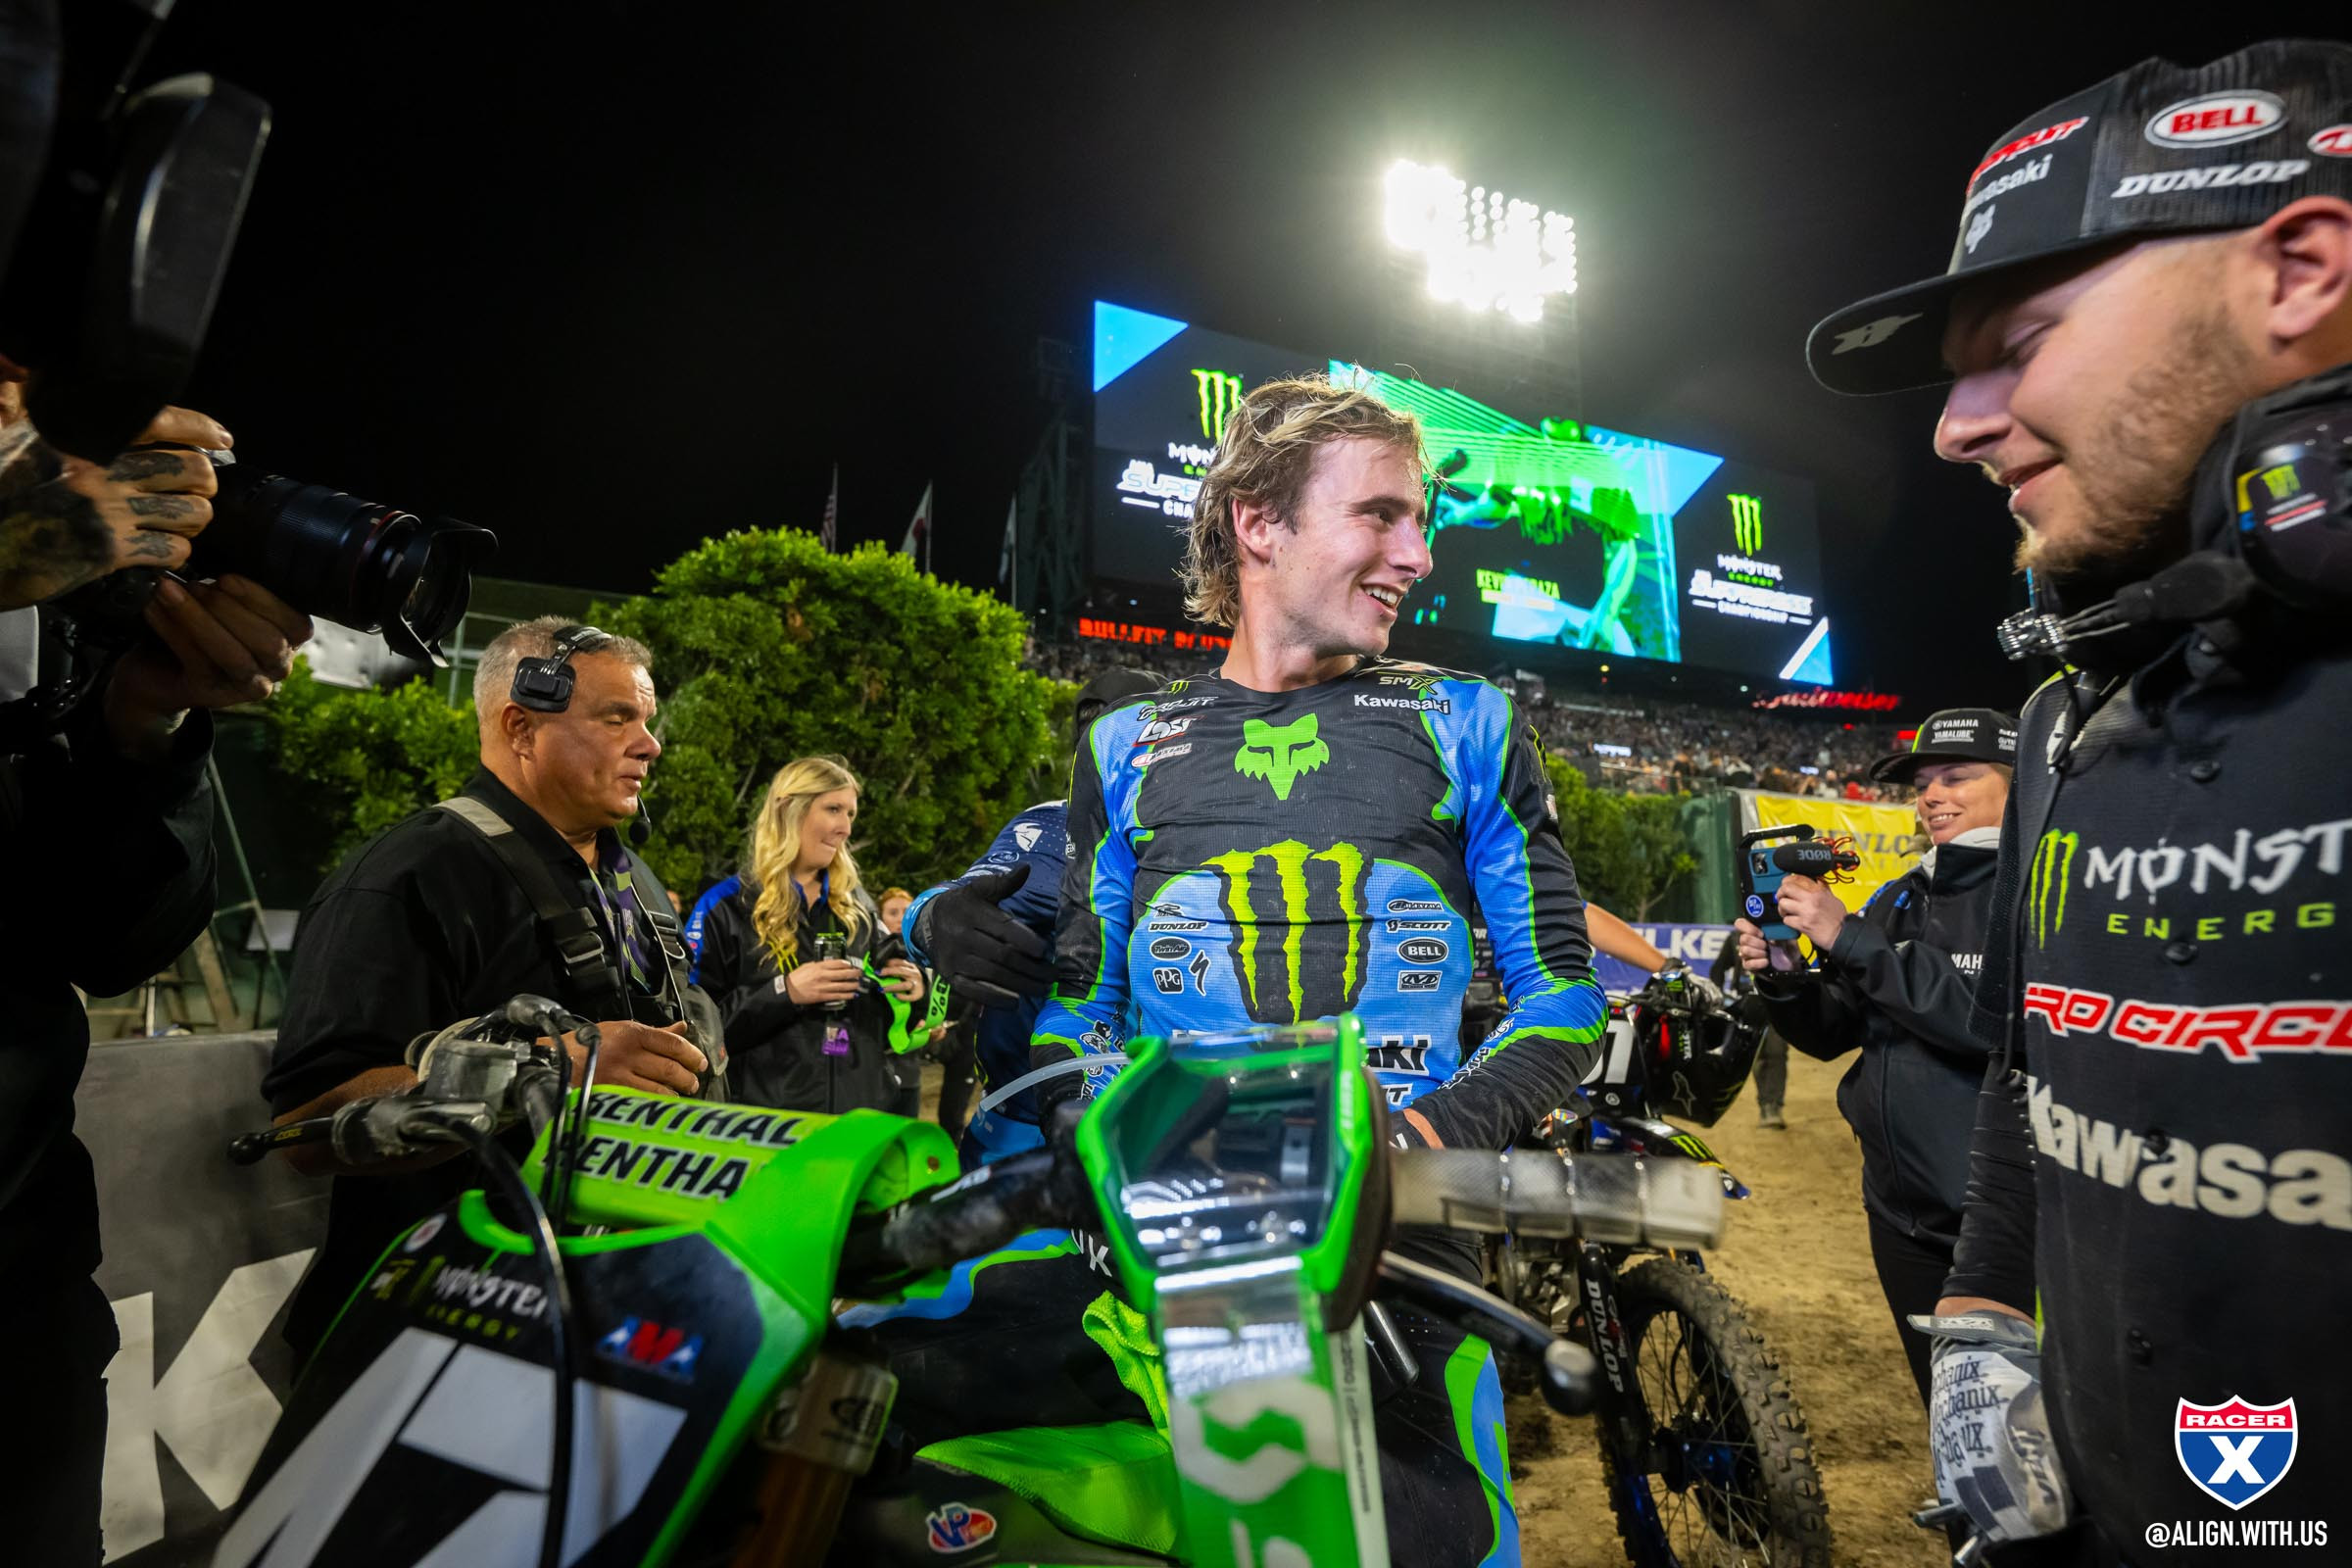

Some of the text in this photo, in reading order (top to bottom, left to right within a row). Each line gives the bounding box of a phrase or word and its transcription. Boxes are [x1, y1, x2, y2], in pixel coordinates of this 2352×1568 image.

[2171, 106, 2260, 134] BELL
[2111, 160, 2310, 197] DUNLOP
[1353, 694, 1450, 715] Kawasaki
[1942, 718, 1979, 728] YAMAHA
[1149, 922, 1207, 931] DUNLOP
[1398, 921, 1450, 930] SCOTT
[1407, 946, 1442, 956] BELL
[1156, 968, 1180, 989] PPG
[2023, 983, 2115, 1037] RO
[543, 1135, 749, 1201] ENTHA
[1586, 1278, 1624, 1393] DUNLOP
